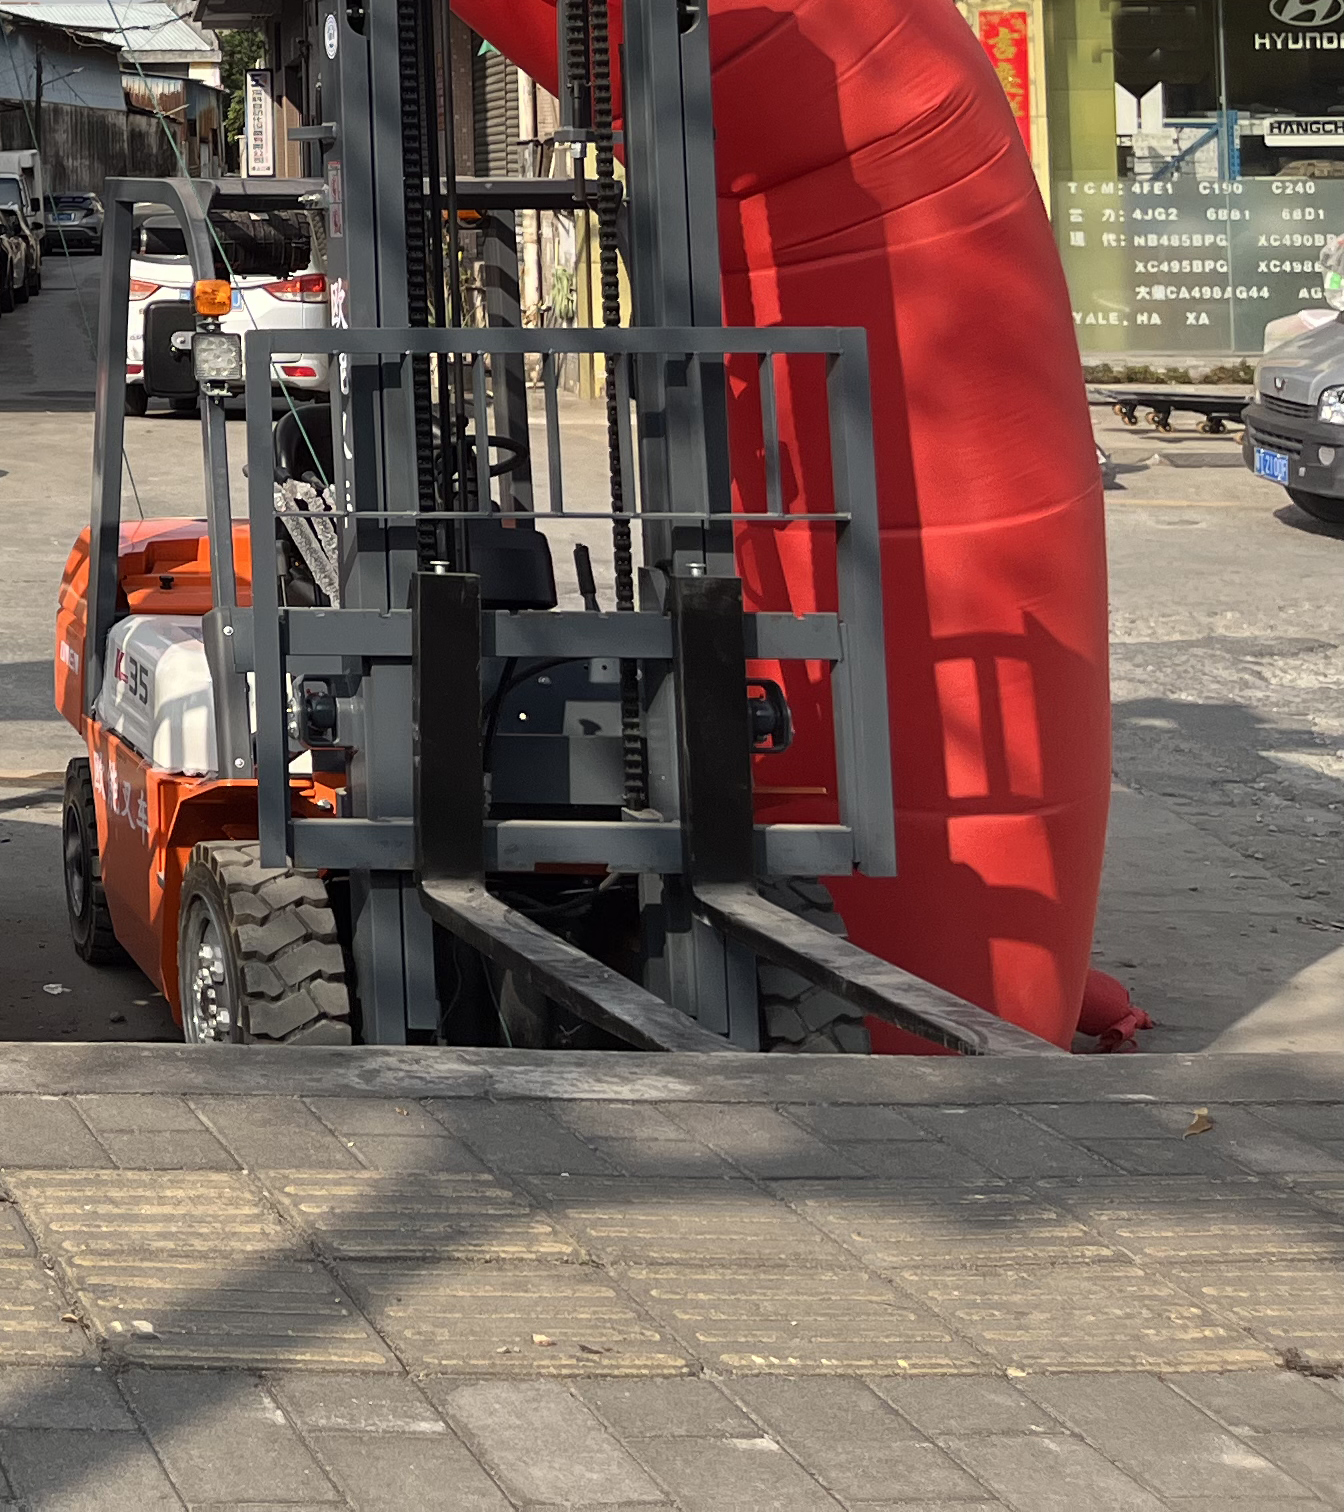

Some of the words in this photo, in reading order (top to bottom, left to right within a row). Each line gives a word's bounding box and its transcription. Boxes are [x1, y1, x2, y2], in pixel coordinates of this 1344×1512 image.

[1254, 32, 1344, 50] HYUND
[1271, 181, 1316, 194] C240
[1132, 208, 1178, 221] 4JG2
[1258, 233, 1337, 247] XC490BP
[1298, 287, 1326, 300] AG
[1136, 312, 1162, 325] HA
[1186, 312, 1210, 325] XA
